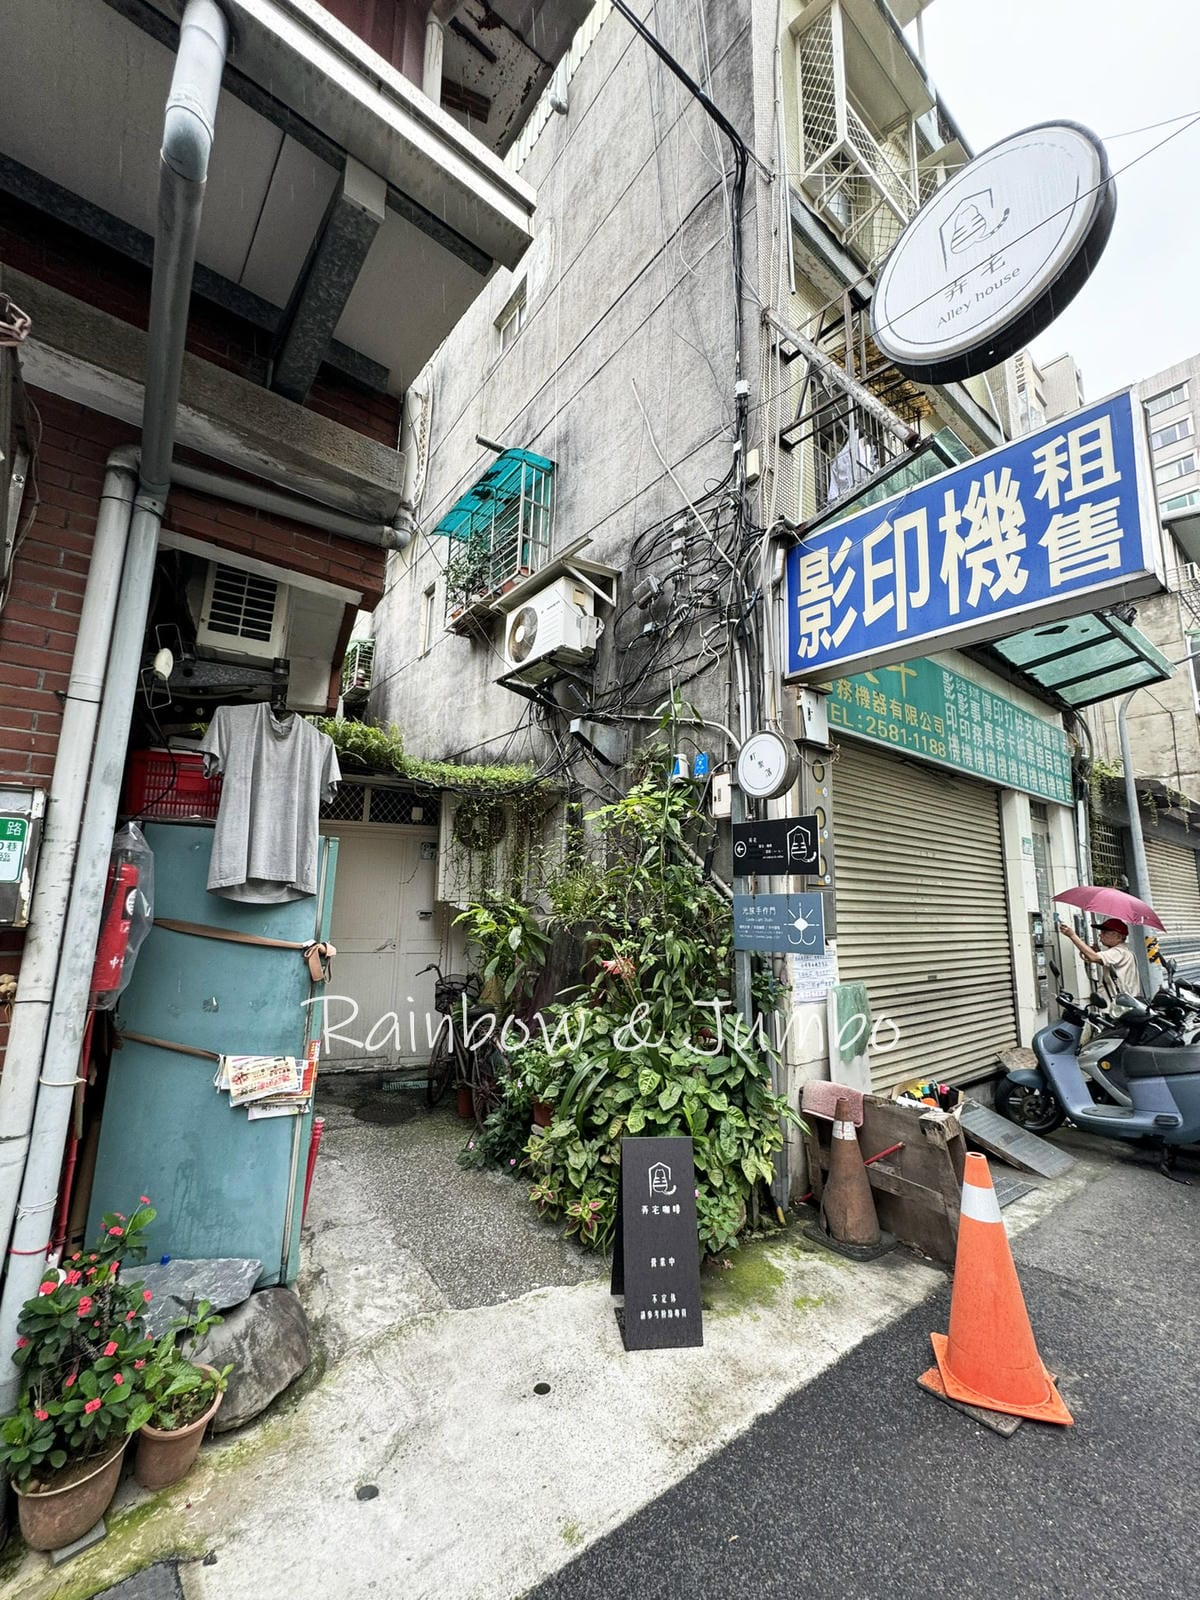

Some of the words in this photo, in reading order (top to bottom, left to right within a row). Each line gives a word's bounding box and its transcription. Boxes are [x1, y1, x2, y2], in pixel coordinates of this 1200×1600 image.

[937, 299, 971, 329] Alley
[975, 267, 1022, 302] house
[1032, 414, 1125, 588] 租售
[796, 466, 1030, 660] 影印機
[942, 671, 961, 763] 影印機
[993, 699, 1009, 781] 印表機
[1004, 703, 1019, 785] 打卡機
[6, 821, 22, 836] 路
